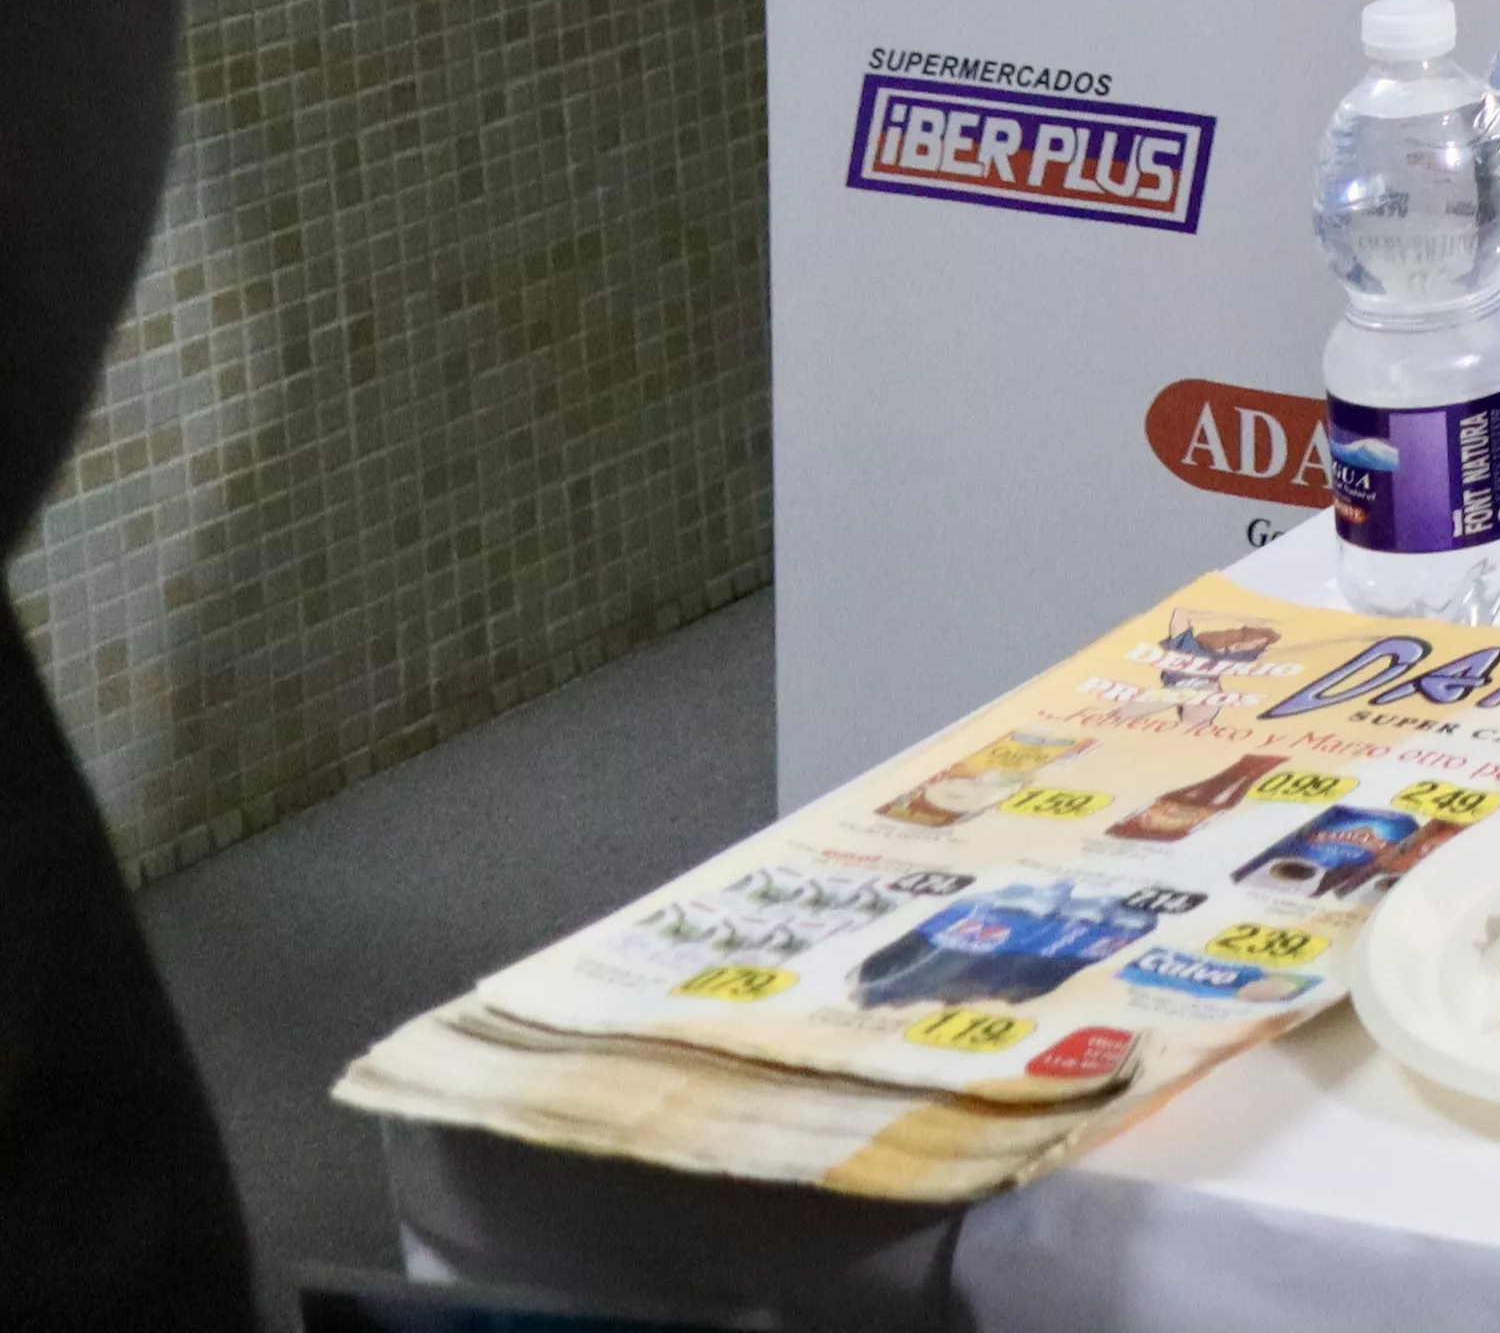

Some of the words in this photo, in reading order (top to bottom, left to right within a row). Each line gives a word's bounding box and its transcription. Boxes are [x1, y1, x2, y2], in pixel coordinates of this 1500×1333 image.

[868, 47, 1113, 97] SUPERMERCADOS
[1027, 123, 1182, 203] PLUS
[1181, 400, 1334, 489] ADA
[1460, 411, 1491, 484] NATURA
[1463, 486, 1493, 536] FONT
[1349, 709, 1462, 736] SUPER
[1294, 730, 1391, 760] Marzo
[1396, 742, 1468, 768] otro
[1137, 951, 1240, 986] Calvo
